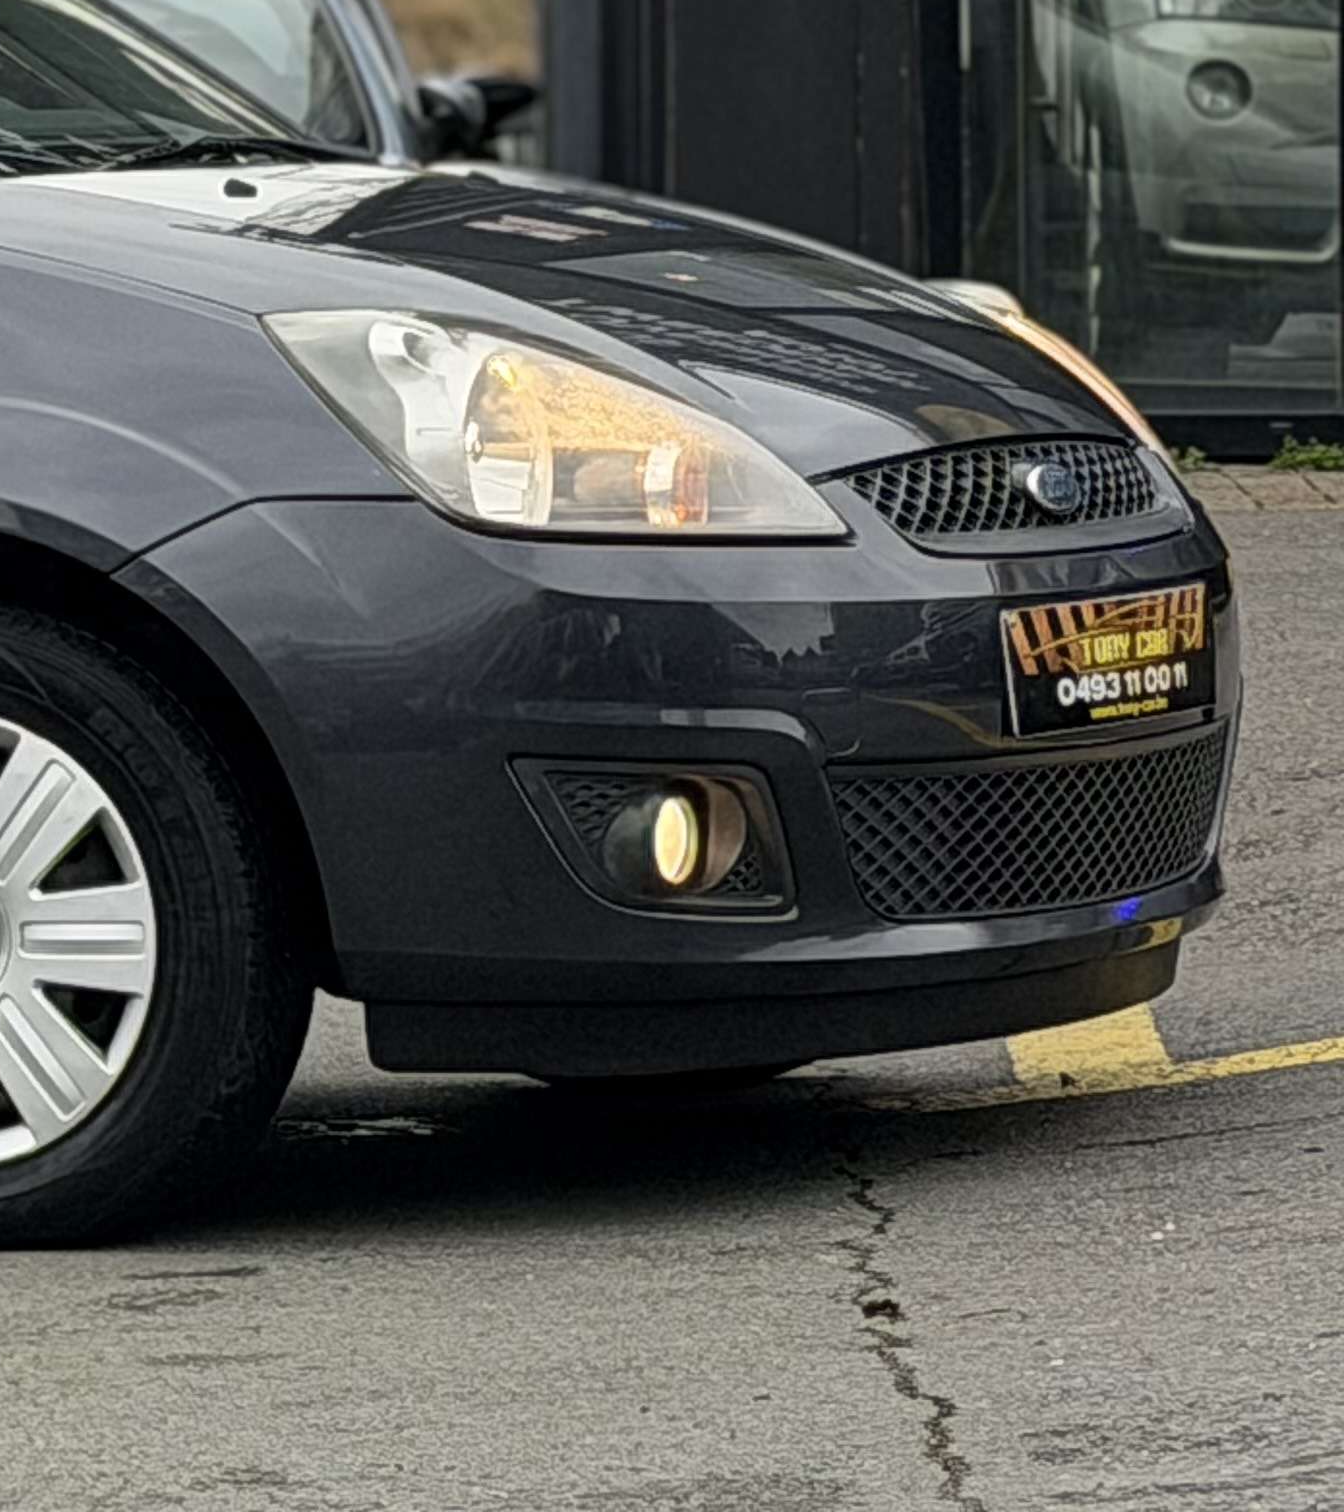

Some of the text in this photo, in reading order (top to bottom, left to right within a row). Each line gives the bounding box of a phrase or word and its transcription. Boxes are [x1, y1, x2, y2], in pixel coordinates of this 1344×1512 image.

[1058, 661, 1188, 706] 0493 11 00 11
